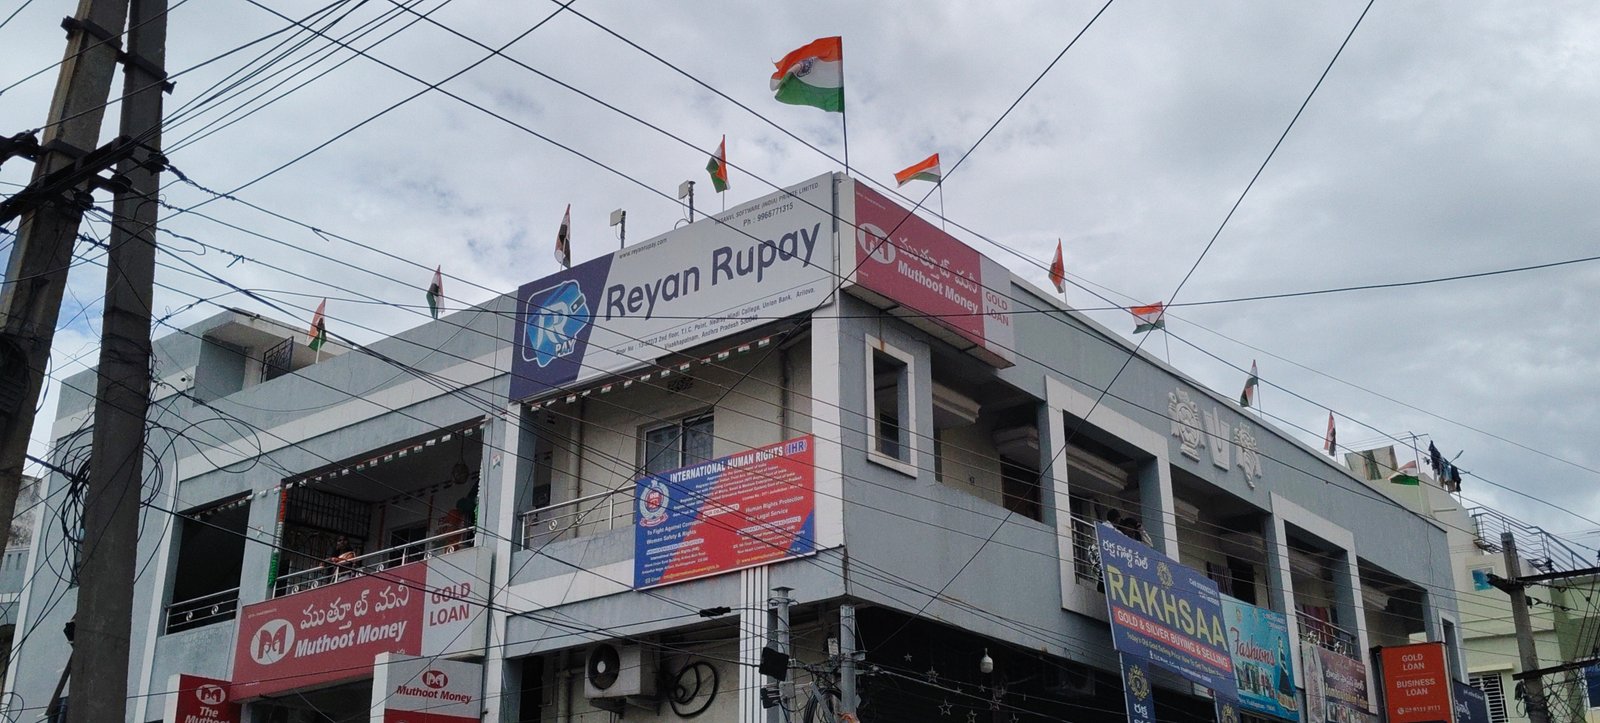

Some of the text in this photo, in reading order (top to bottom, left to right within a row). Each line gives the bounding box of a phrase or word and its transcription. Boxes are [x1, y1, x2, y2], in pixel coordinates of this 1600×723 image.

[799, 183, 819, 195] LIMITED
[606, 222, 821, 321] Reyan Rupay
[897, 260, 979, 315] Muthoot Money
[762, 299, 777, 309] Union
[985, 291, 1008, 311] GOLD
[986, 308, 1009, 327] LOAN
[556, 339, 576, 355] PAY
[670, 461, 726, 485] INTERNATIONAL
[728, 453, 754, 469] HUMAN
[756, 446, 783, 462] RIGHTS
[746, 496, 804, 513] Human Rights Protection
[431, 582, 471, 605] GOLD
[430, 604, 470, 627] LOAN
[1107, 564, 1229, 652] RAKHSAA
[294, 620, 408, 658] Muthoot Money
[1117, 610, 1138, 627] GOLD
[1146, 622, 1170, 641] SILVER
[1171, 633, 1195, 652] BUYING
[1201, 647, 1229, 668] SELLING
[1230, 626, 1275, 667] Fashions
[1401, 653, 1424, 662] GOLD
[1403, 661, 1425, 671] LOAN
[1396, 678, 1436, 689] BUSINESS
[1406, 688, 1428, 697] LOAN
[396, 685, 472, 705] Muthoot Money
[199, 706, 219, 718] The
